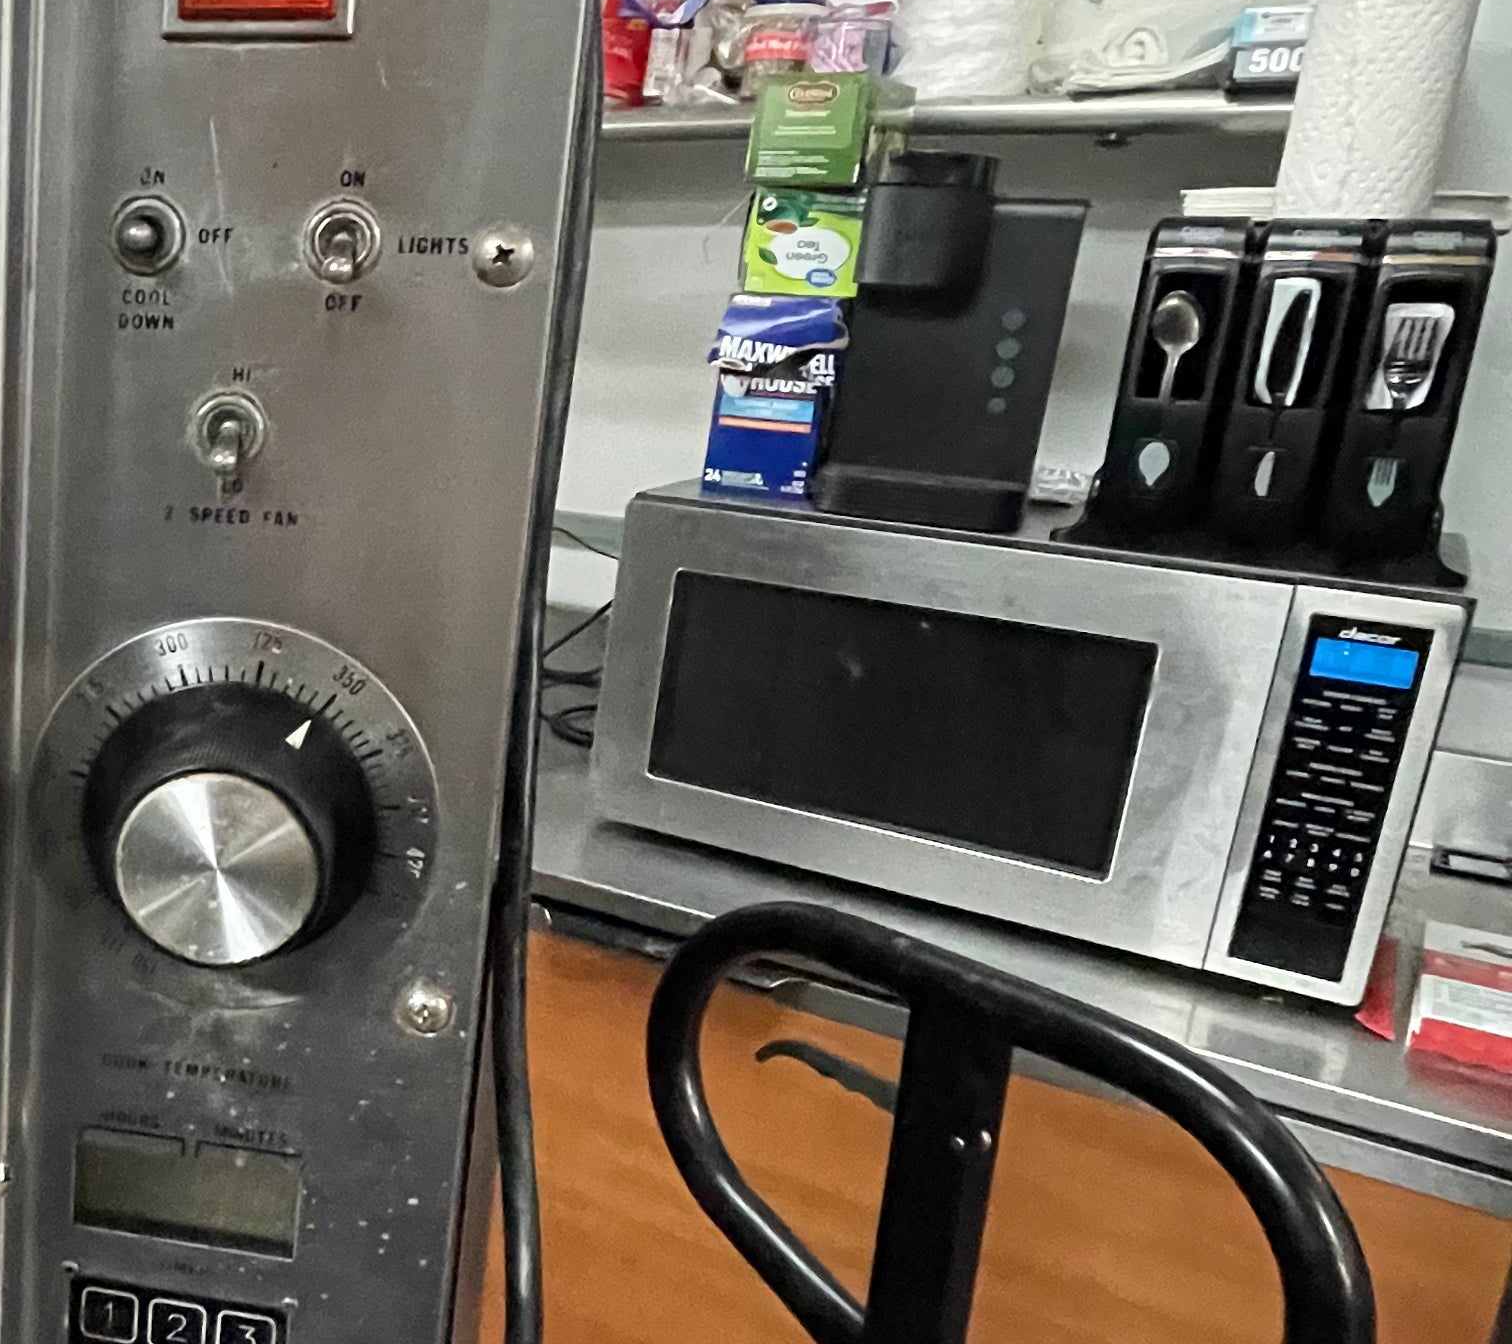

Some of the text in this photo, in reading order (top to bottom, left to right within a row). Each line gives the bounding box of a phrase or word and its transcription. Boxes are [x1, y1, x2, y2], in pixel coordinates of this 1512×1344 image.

[339, 169, 366, 188] ON
[199, 228, 234, 244] OFF
[397, 236, 469, 257] LIGHTS
[122, 287, 171, 306] COOL
[325, 293, 363, 312] OFF
[117, 312, 174, 331] DOWN
[232, 368, 251, 381] HI
[705, 468, 721, 481] 24
[190, 507, 298, 526] SPEED FAN
[153, 633, 189, 656] 300
[332, 663, 366, 697] 350
[103, 1301, 115, 1322] 1
[165, 1313, 188, 1342] 2
